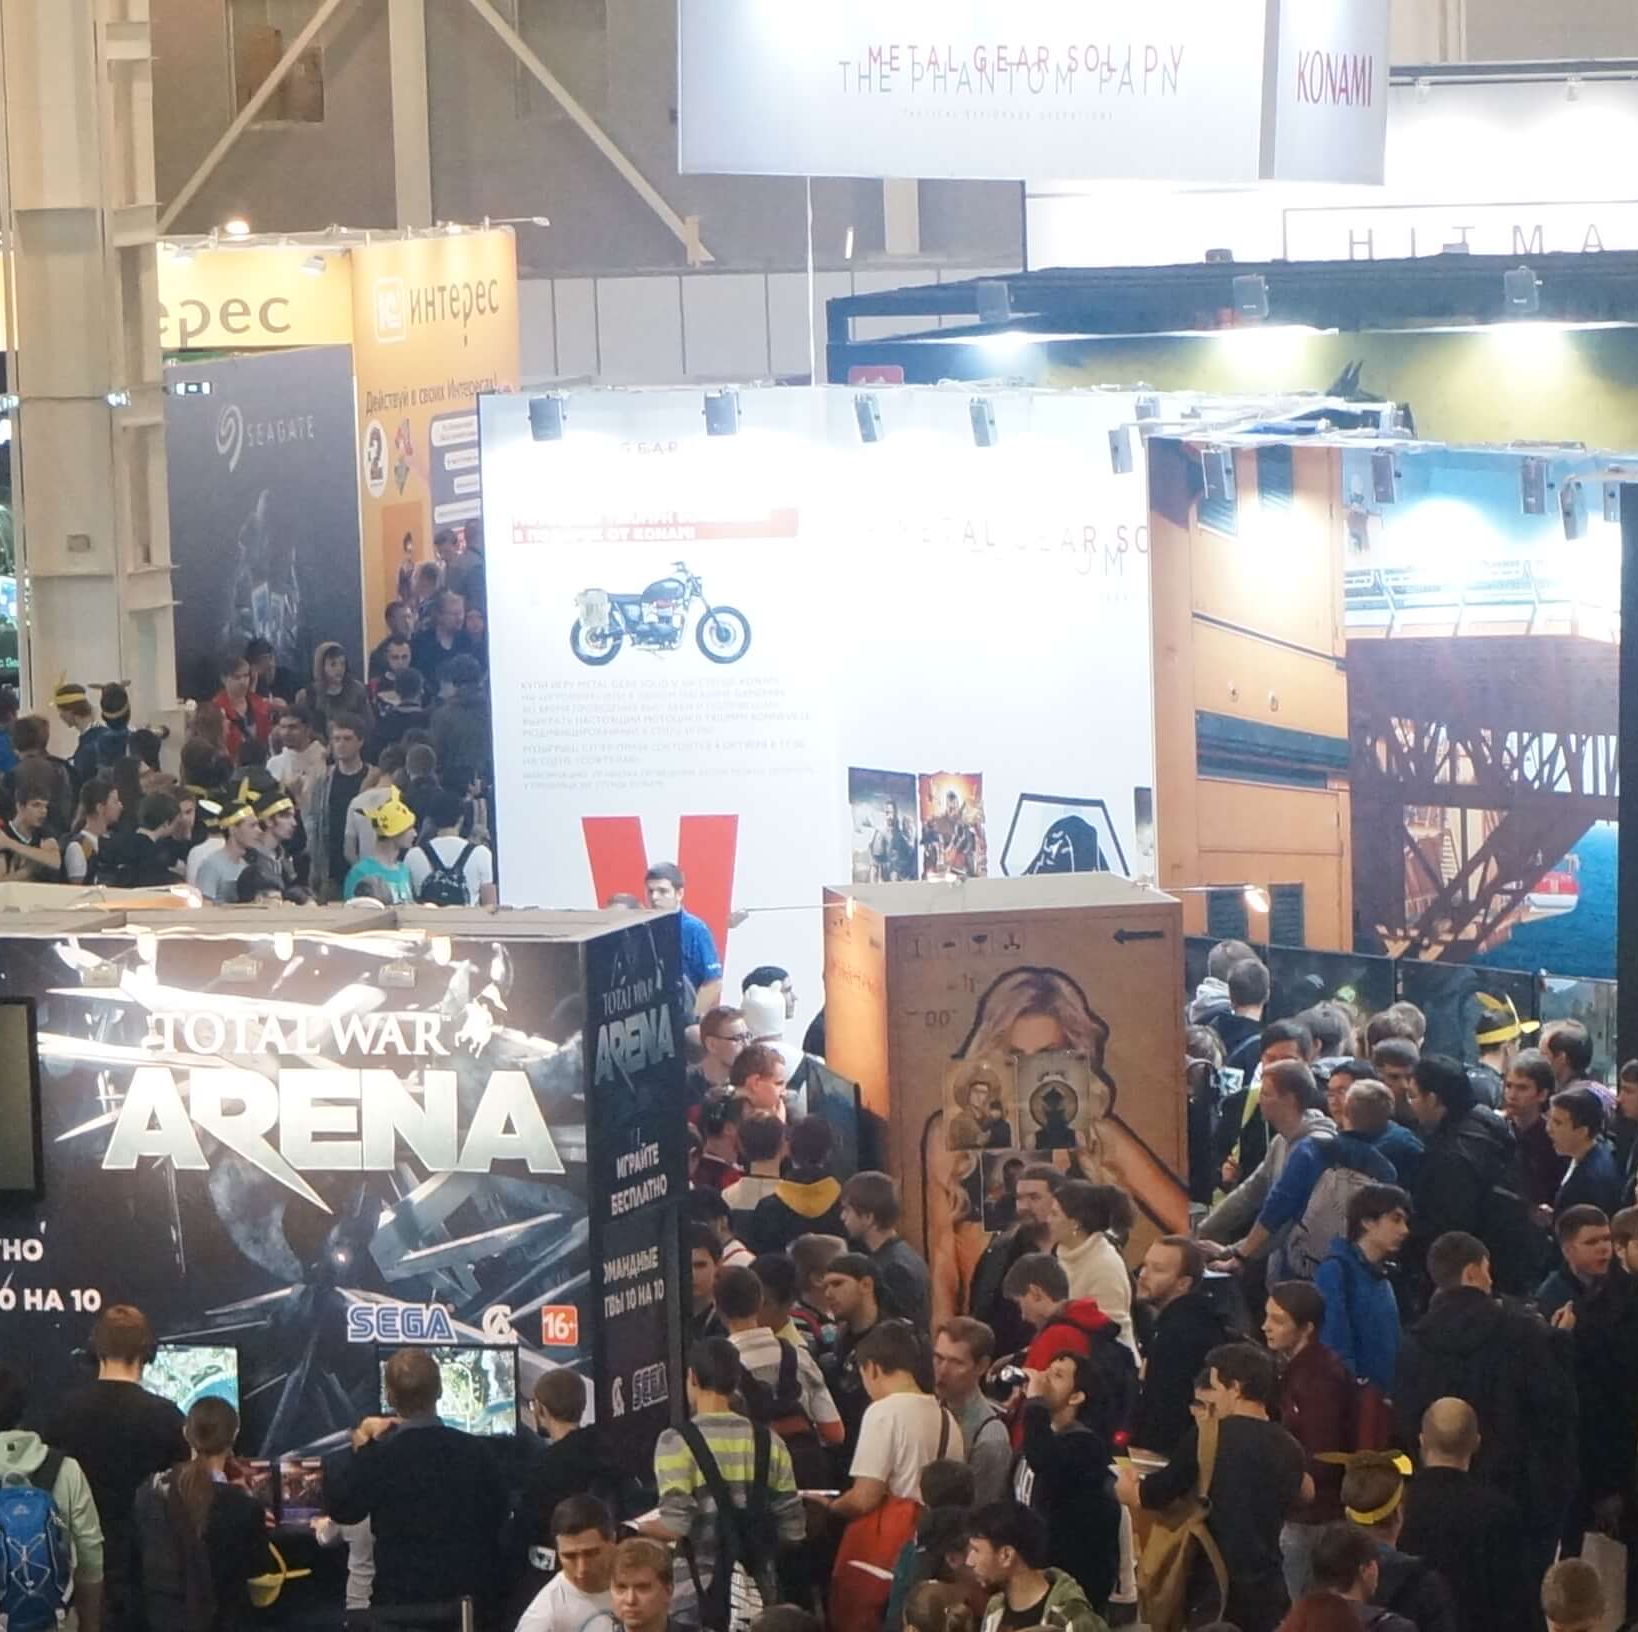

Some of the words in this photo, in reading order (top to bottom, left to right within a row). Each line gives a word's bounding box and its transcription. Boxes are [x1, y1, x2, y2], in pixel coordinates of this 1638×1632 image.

[839, 61, 892, 94] THE
[911, 61, 1074, 95] PHANTOM
[1099, 60, 1178, 96] PAIN
[868, 45, 958, 73] METAL
[973, 45, 1050, 73] GEAR
[1067, 44, 1159, 73] SOLID
[1296, 50, 1374, 109] KONAMI
[409, 278, 500, 332] интерес
[246, 413, 316, 448] SEAGATE
[153, 1011, 321, 1055] TOTAL
[329, 1011, 449, 1055] WAR
[594, 1003, 676, 1092] ARENA
[101, 1069, 566, 1214] ARENA
[616, 1141, 660, 1180] ИГРАЙТЕ
[610, 1173, 668, 1217] БЕСПЛАТНО
[23, 1288, 63, 1313] НА
[71, 1288, 102, 1313] 10
[347, 1301, 457, 1342] SEGA
[632, 1361, 669, 1412] SEGA
